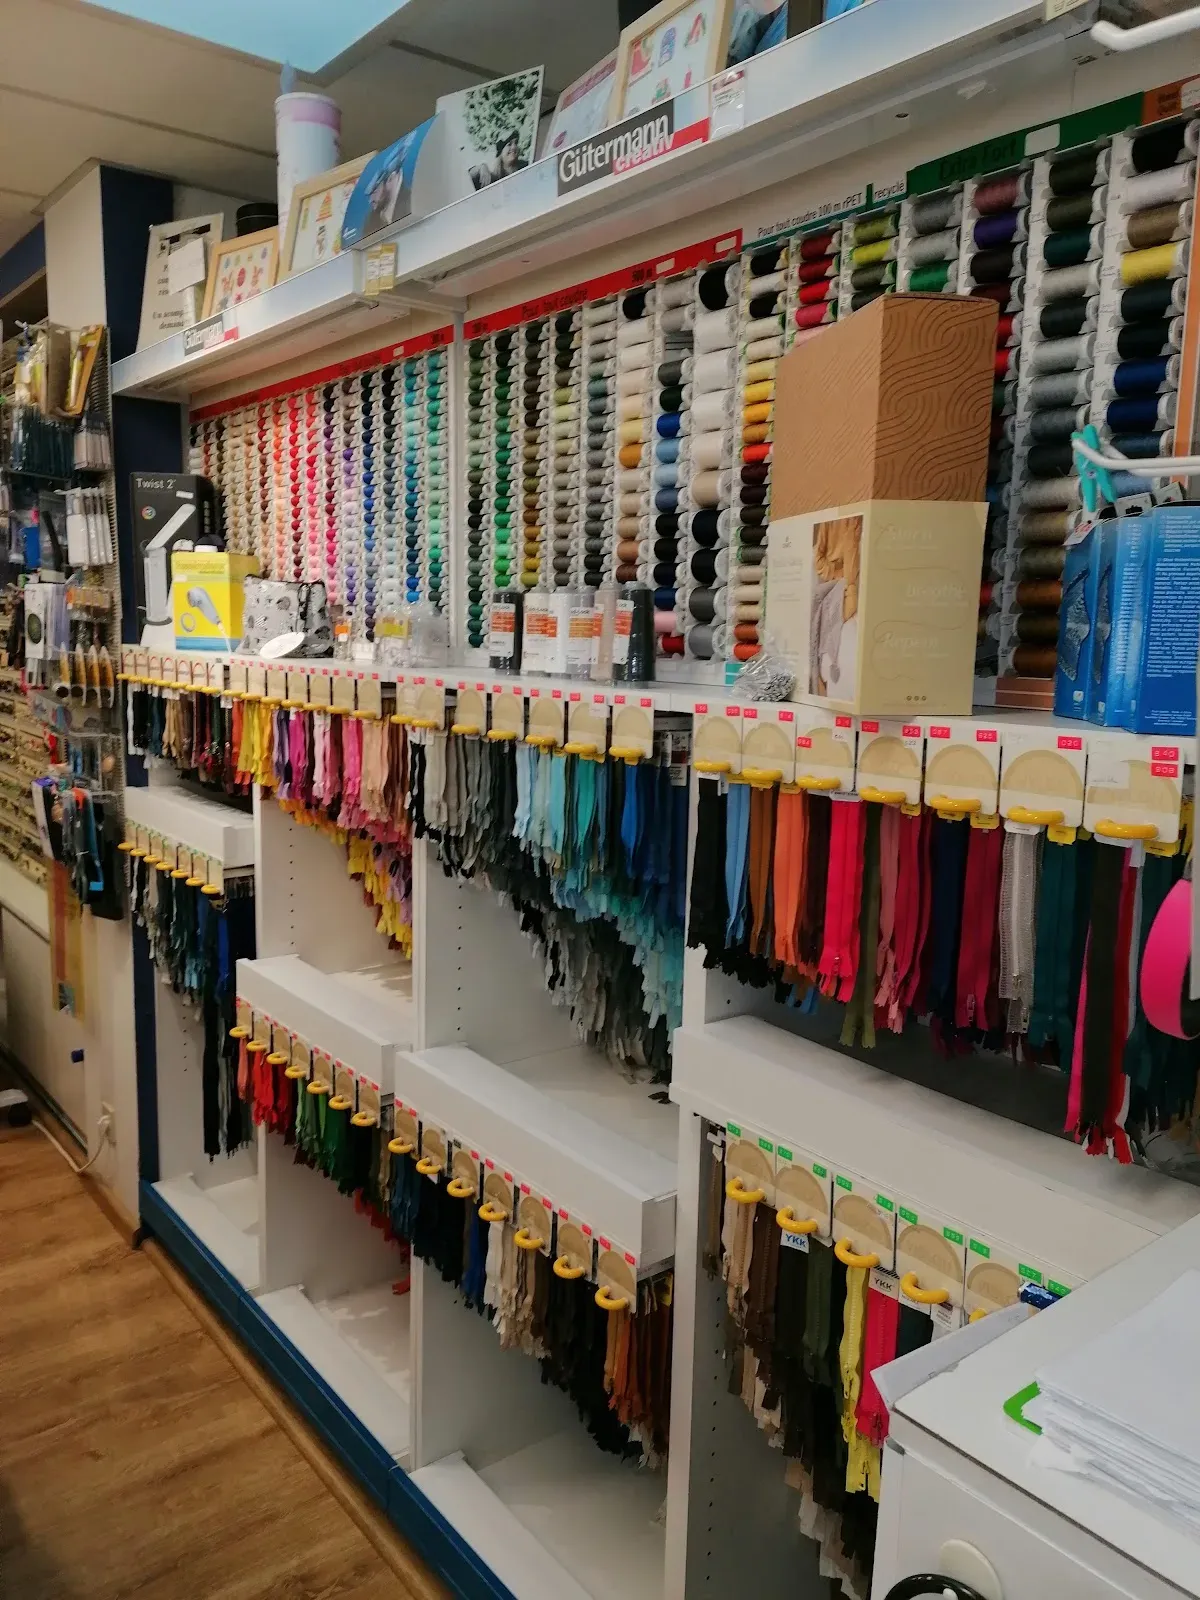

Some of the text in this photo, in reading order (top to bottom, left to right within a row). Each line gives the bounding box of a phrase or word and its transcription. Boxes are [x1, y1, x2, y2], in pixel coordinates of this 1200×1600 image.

[559, 114, 669, 183] Gütermann
[615, 132, 675, 172] creativ
[874, 179, 905, 201] recyclé
[757, 223, 774, 238] Pour
[791, 210, 817, 227] coudre
[842, 192, 863, 209] rPET
[136, 477, 165, 489] Twist
[785, 1233, 807, 1248] YKK
[874, 1277, 893, 1291] YKK
